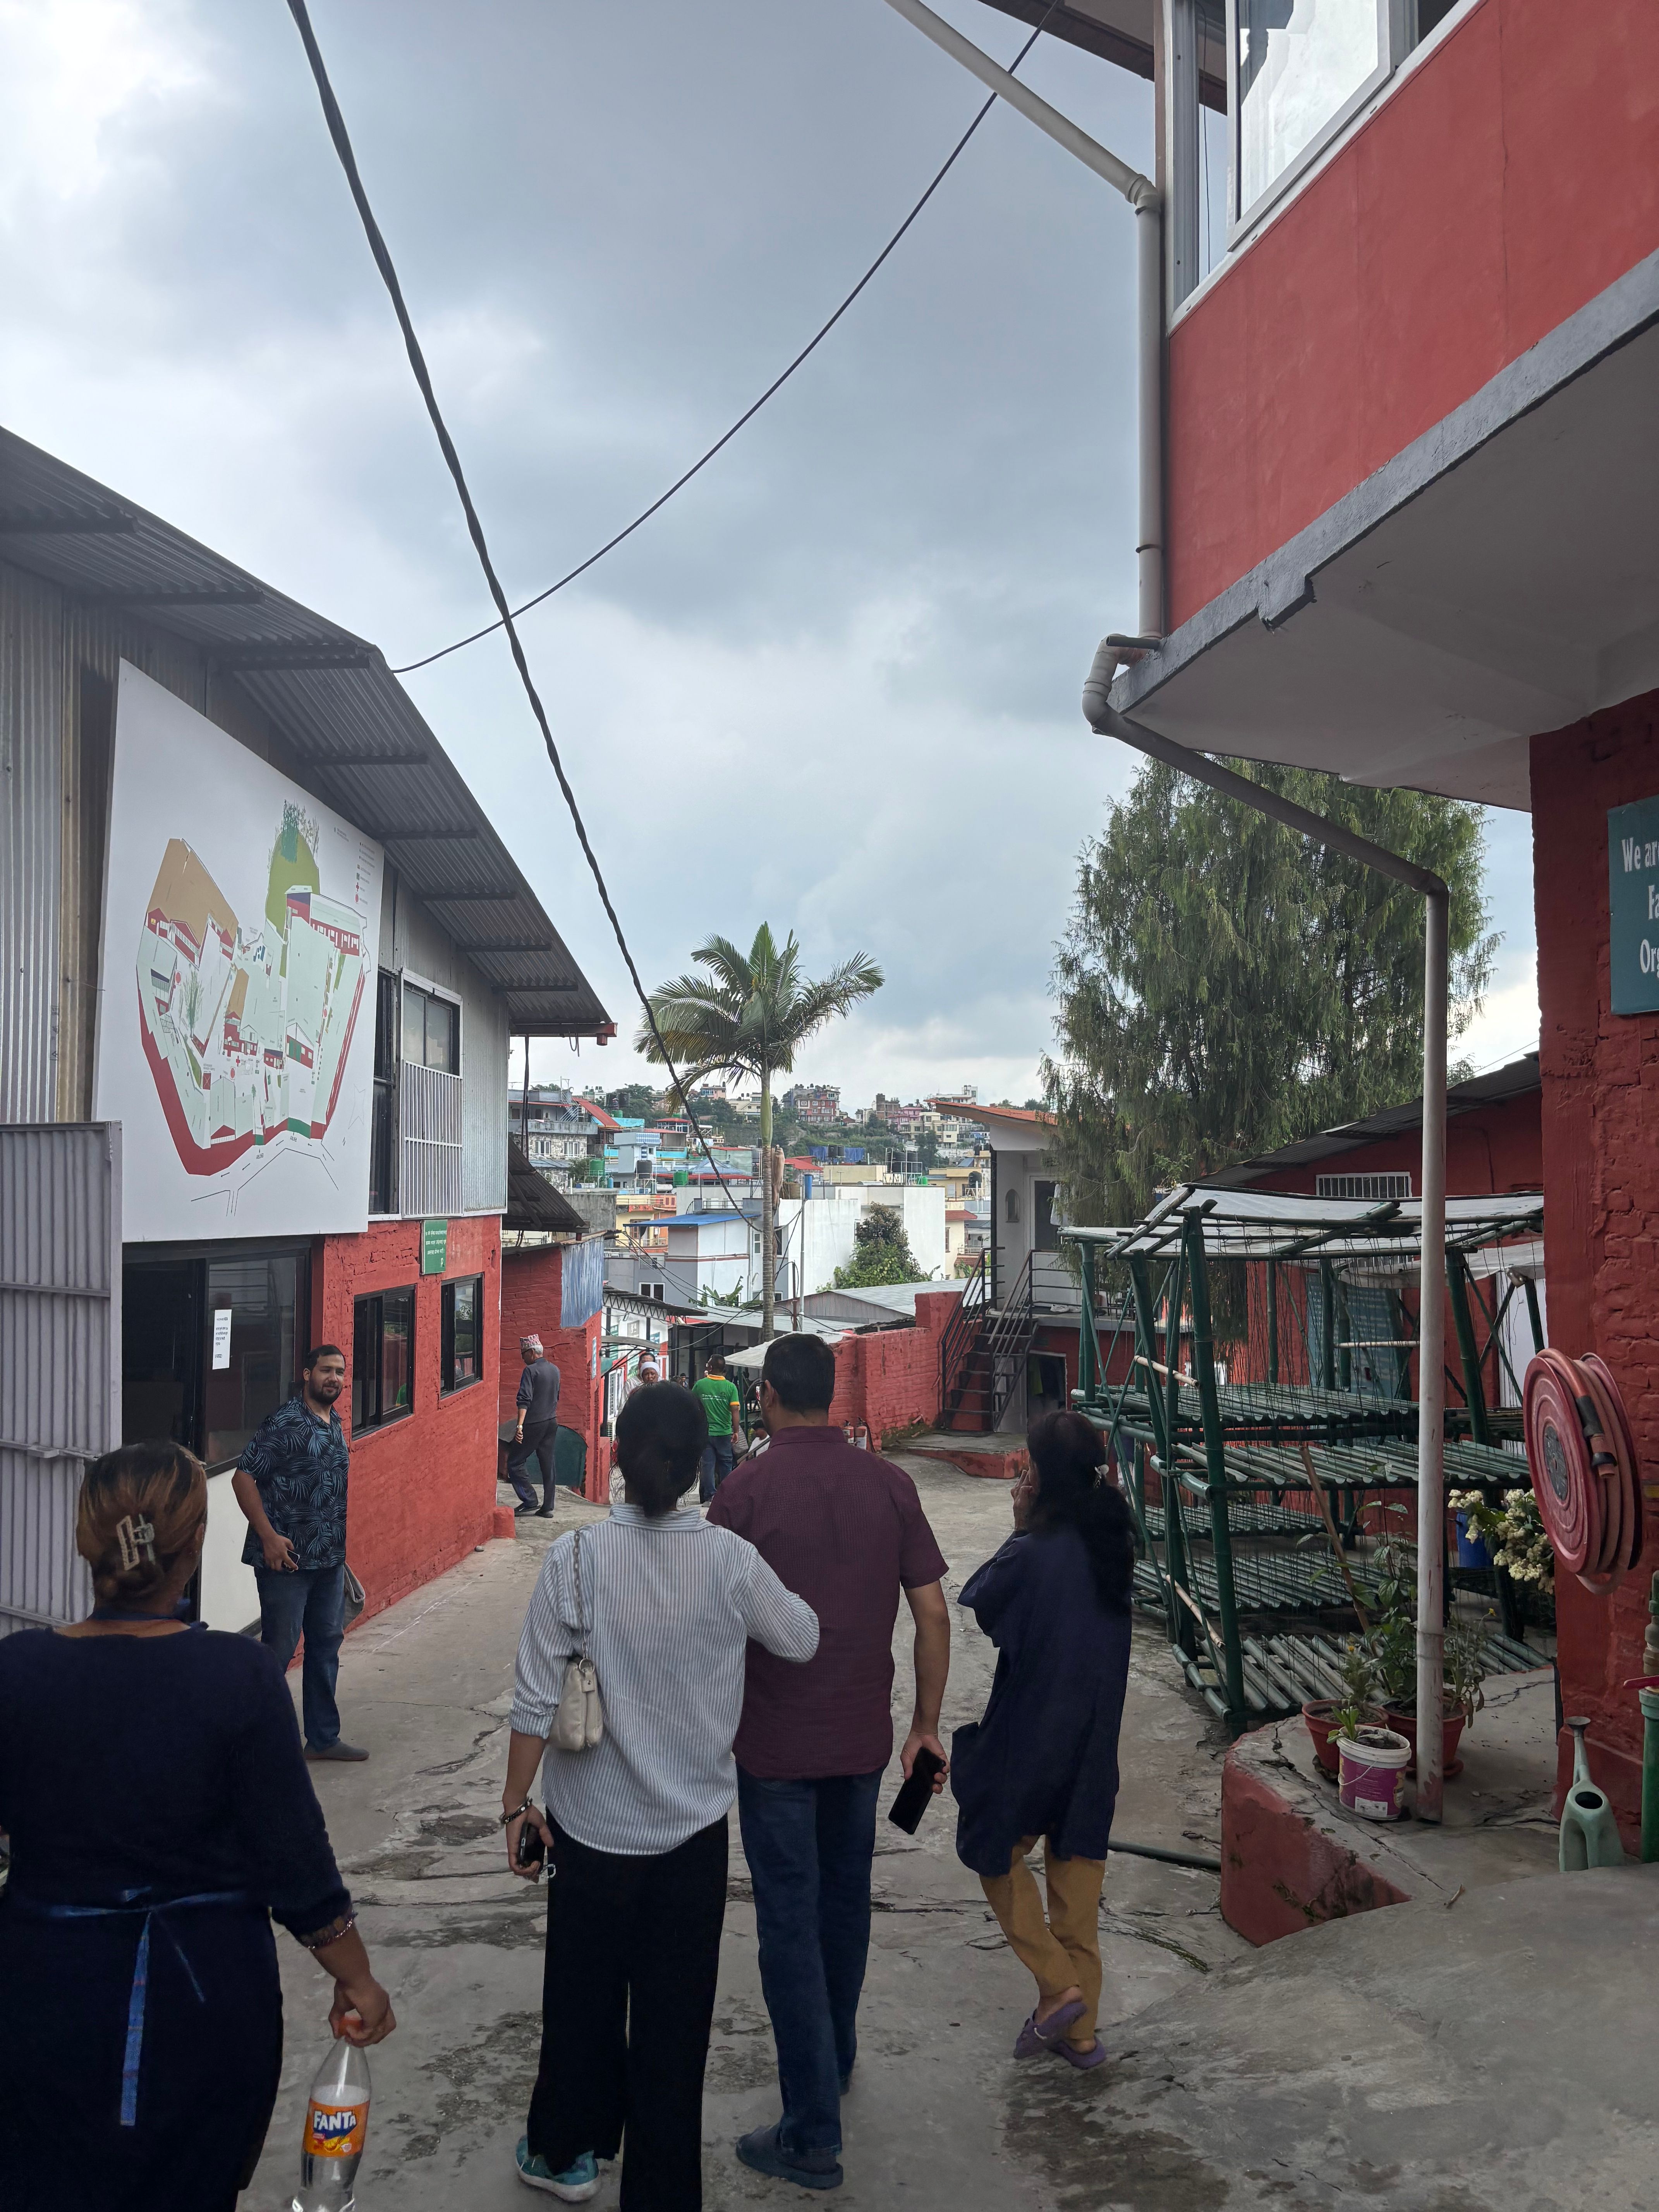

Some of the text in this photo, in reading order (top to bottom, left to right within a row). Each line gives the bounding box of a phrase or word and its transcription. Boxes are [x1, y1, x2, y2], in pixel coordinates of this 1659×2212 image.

[1621, 837, 1659, 872] We ar
[313, 2111, 357, 2131] FANTA
